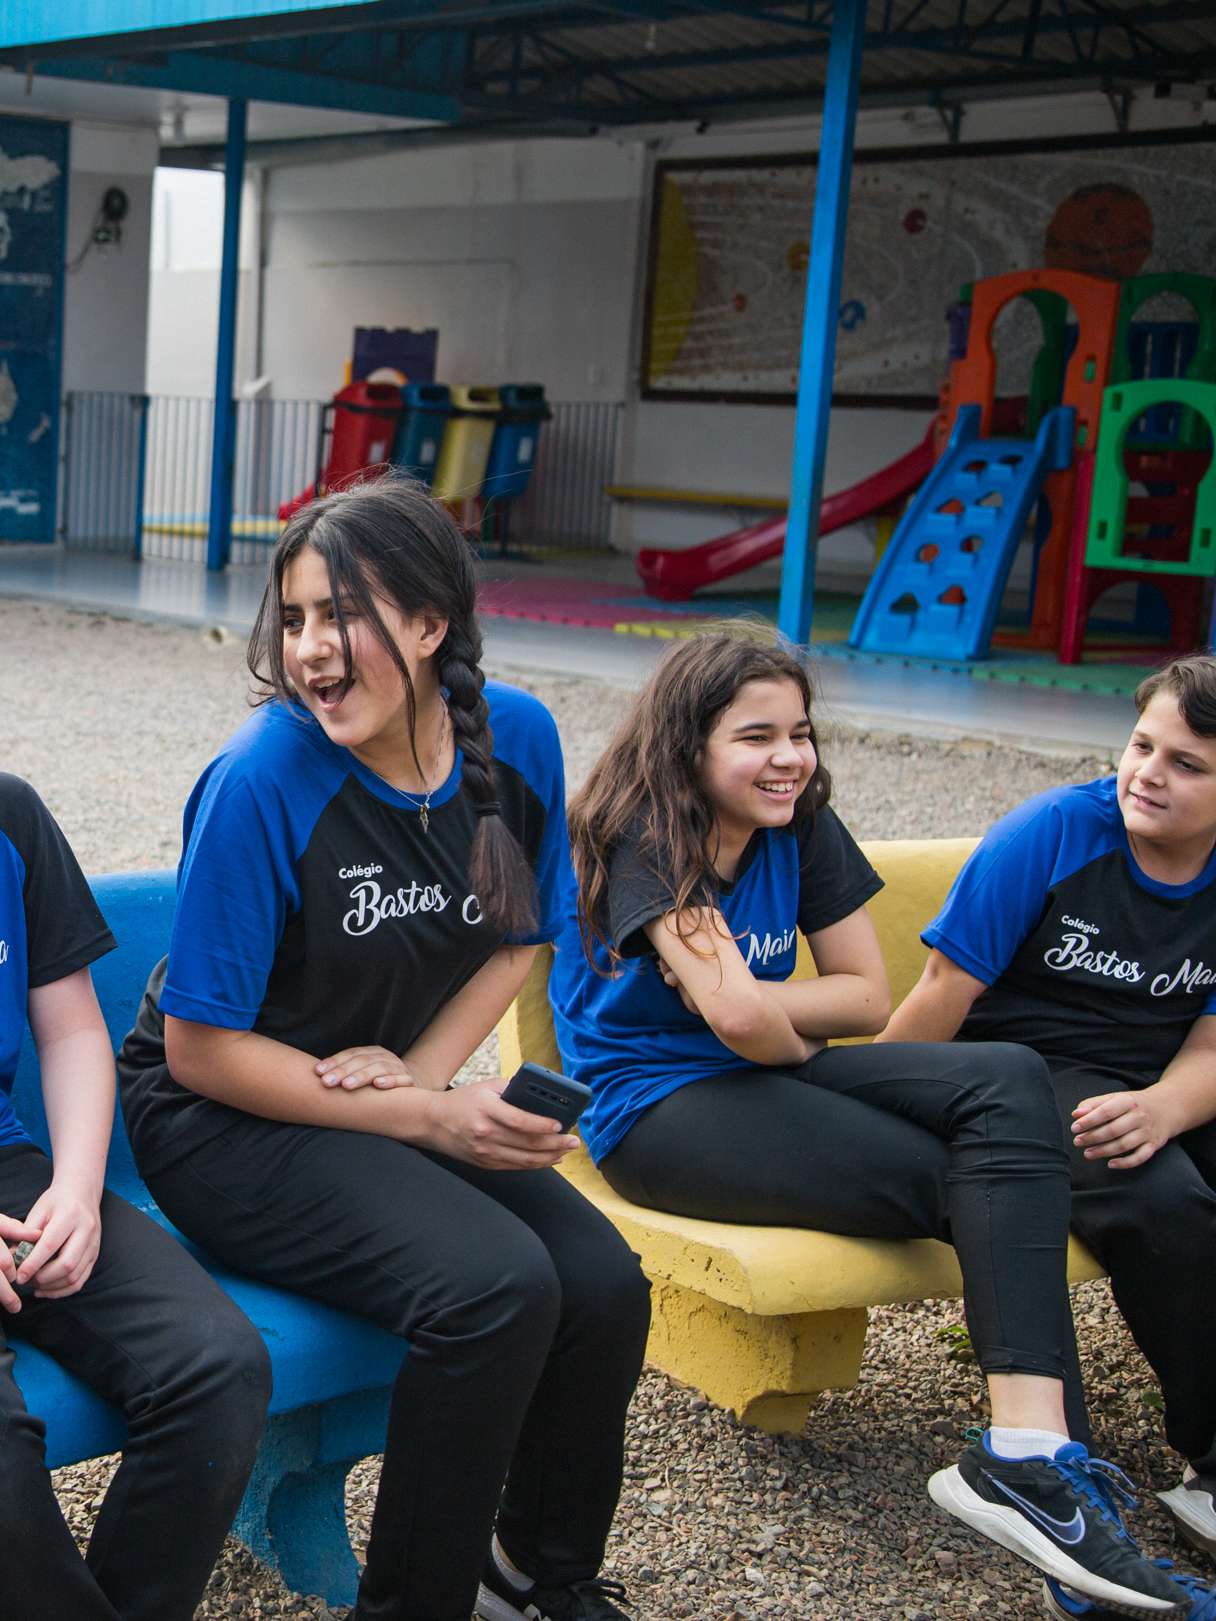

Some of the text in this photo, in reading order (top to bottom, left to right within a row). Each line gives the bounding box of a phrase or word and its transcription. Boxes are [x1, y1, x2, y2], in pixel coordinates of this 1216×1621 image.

[338, 863, 384, 879] Colégio
[342, 880, 453, 936] Bastos
[1061, 915, 1101, 935] Colégio
[1044, 933, 1216, 996] Bastos Ma
